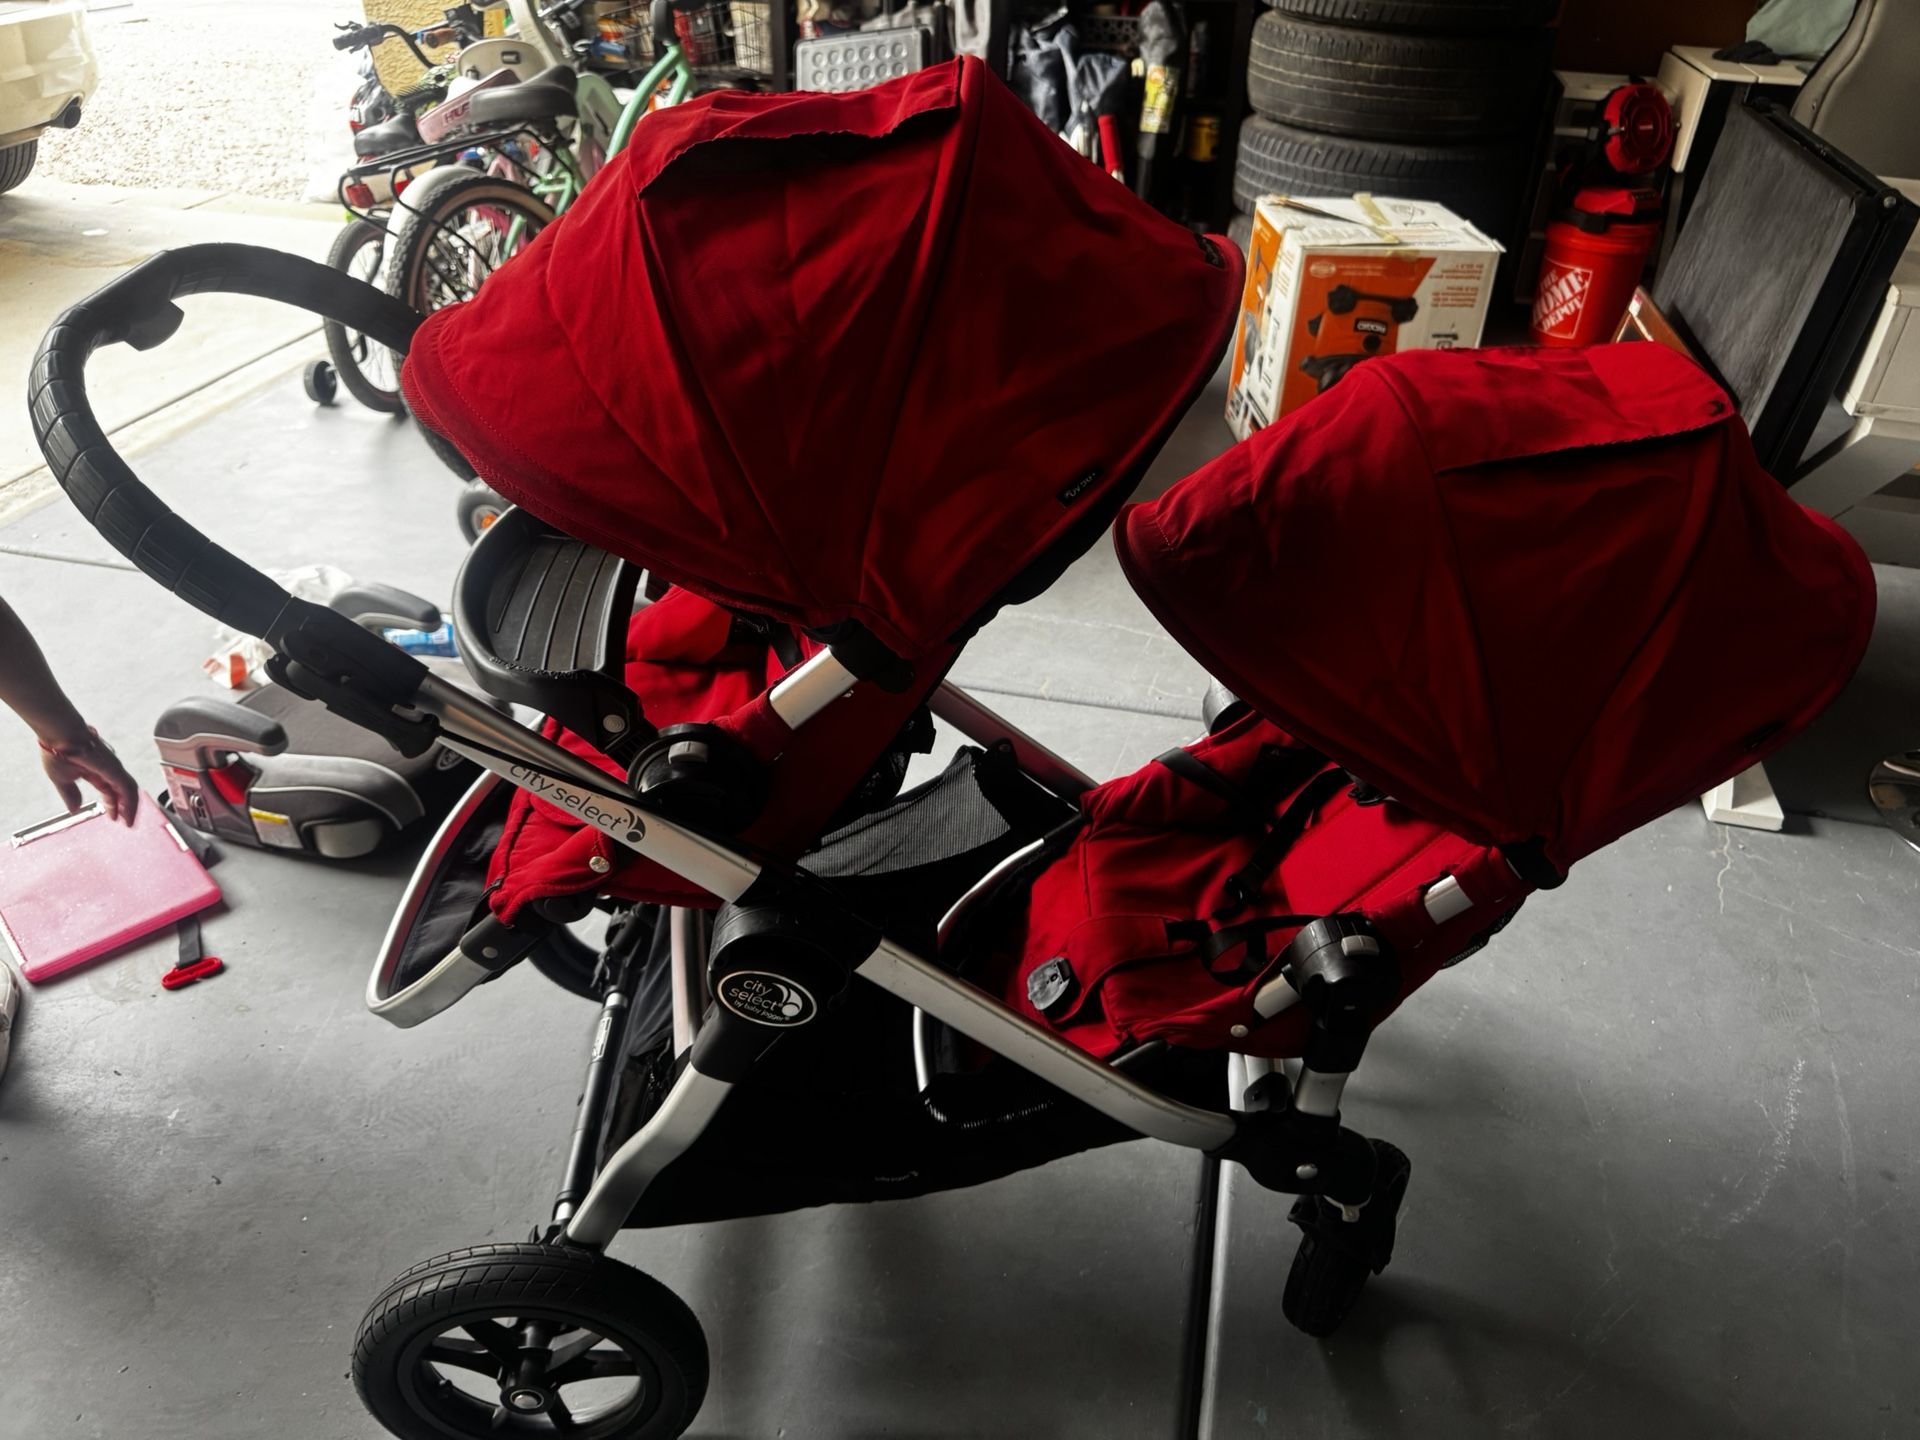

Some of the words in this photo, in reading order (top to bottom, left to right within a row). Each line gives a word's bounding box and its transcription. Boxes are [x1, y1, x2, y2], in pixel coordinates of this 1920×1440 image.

[1533, 267, 1589, 327] HOME
[1541, 295, 1583, 333] DEPOT
[509, 764, 554, 793] city
[551, 786, 623, 832] select
[728, 987, 778, 1011] select
[743, 980, 773, 997] city
[734, 999, 744, 1008] by
[744, 1003, 761, 1014] baby
